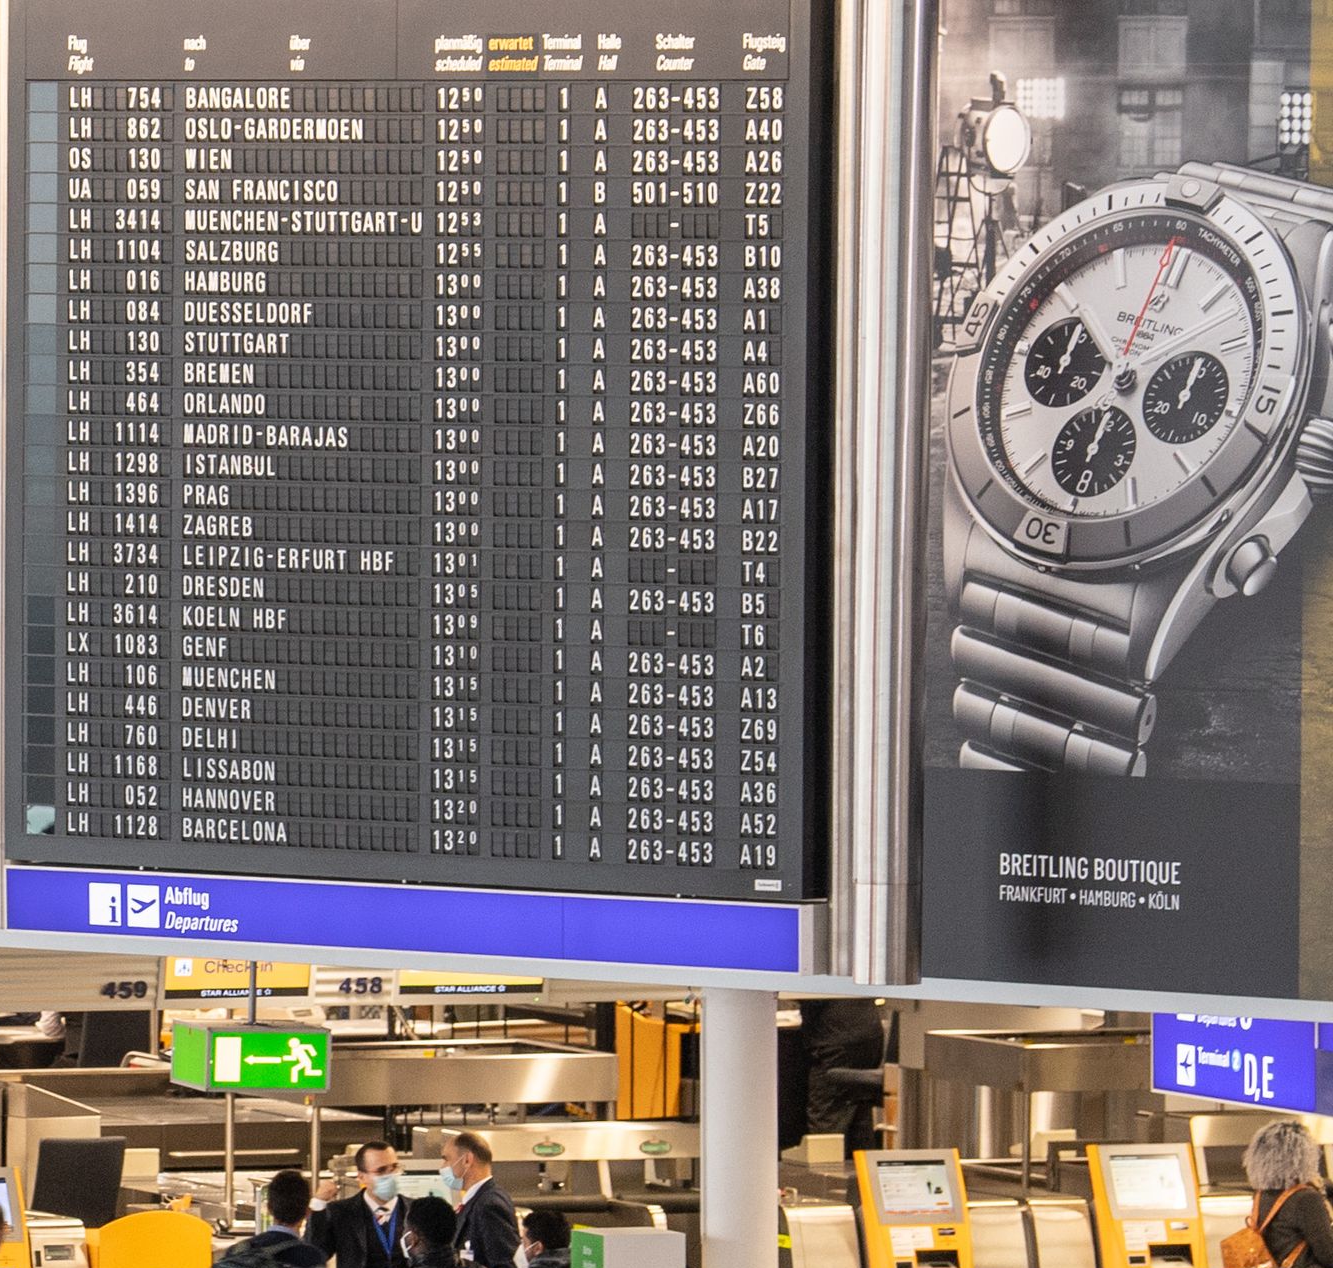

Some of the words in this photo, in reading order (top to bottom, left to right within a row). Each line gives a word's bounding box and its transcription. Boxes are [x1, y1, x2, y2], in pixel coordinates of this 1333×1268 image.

[488, 35, 534, 51] erwartet
[542, 34, 582, 50] Terminal
[597, 34, 622, 50] Halle
[655, 33, 695, 50] Schalter
[488, 55, 539, 72] estimated
[543, 55, 583, 72] Terminal
[597, 55, 618, 72] Hall
[656, 55, 694, 72] Counter
[742, 55, 767, 71] Gate
[68, 86, 93, 108] LH
[126, 86, 162, 109] 754
[184, 87, 292, 109] BANGALORE
[632, 86, 720, 110] 263-453
[745, 86, 784, 110] Z58
[184, 148, 233, 170] WIEN
[184, 239, 280, 263] SALZBURG
[183, 270, 267, 293] HAMBURG
[183, 392, 266, 415] ORLANDO
[182, 514, 254, 537] ZAGREB
[181, 696, 252, 720] DENVER
[181, 787, 276, 812] HANNOVER
[181, 817, 288, 843] BARCELONA
[999, 852, 1090, 880] BREITLING
[1093, 858, 1182, 885] BOUTIQUE
[164, 886, 210, 910] Abflug
[999, 884, 1068, 905] FRANKFURT
[1078, 888, 1136, 909] HAMBURG
[1148, 890, 1181, 912] KÖLN
[164, 911, 239, 933] Departures
[101, 981, 147, 999] 459
[339, 976, 382, 994] 458
[1244, 1053, 1275, 1102] D,E
